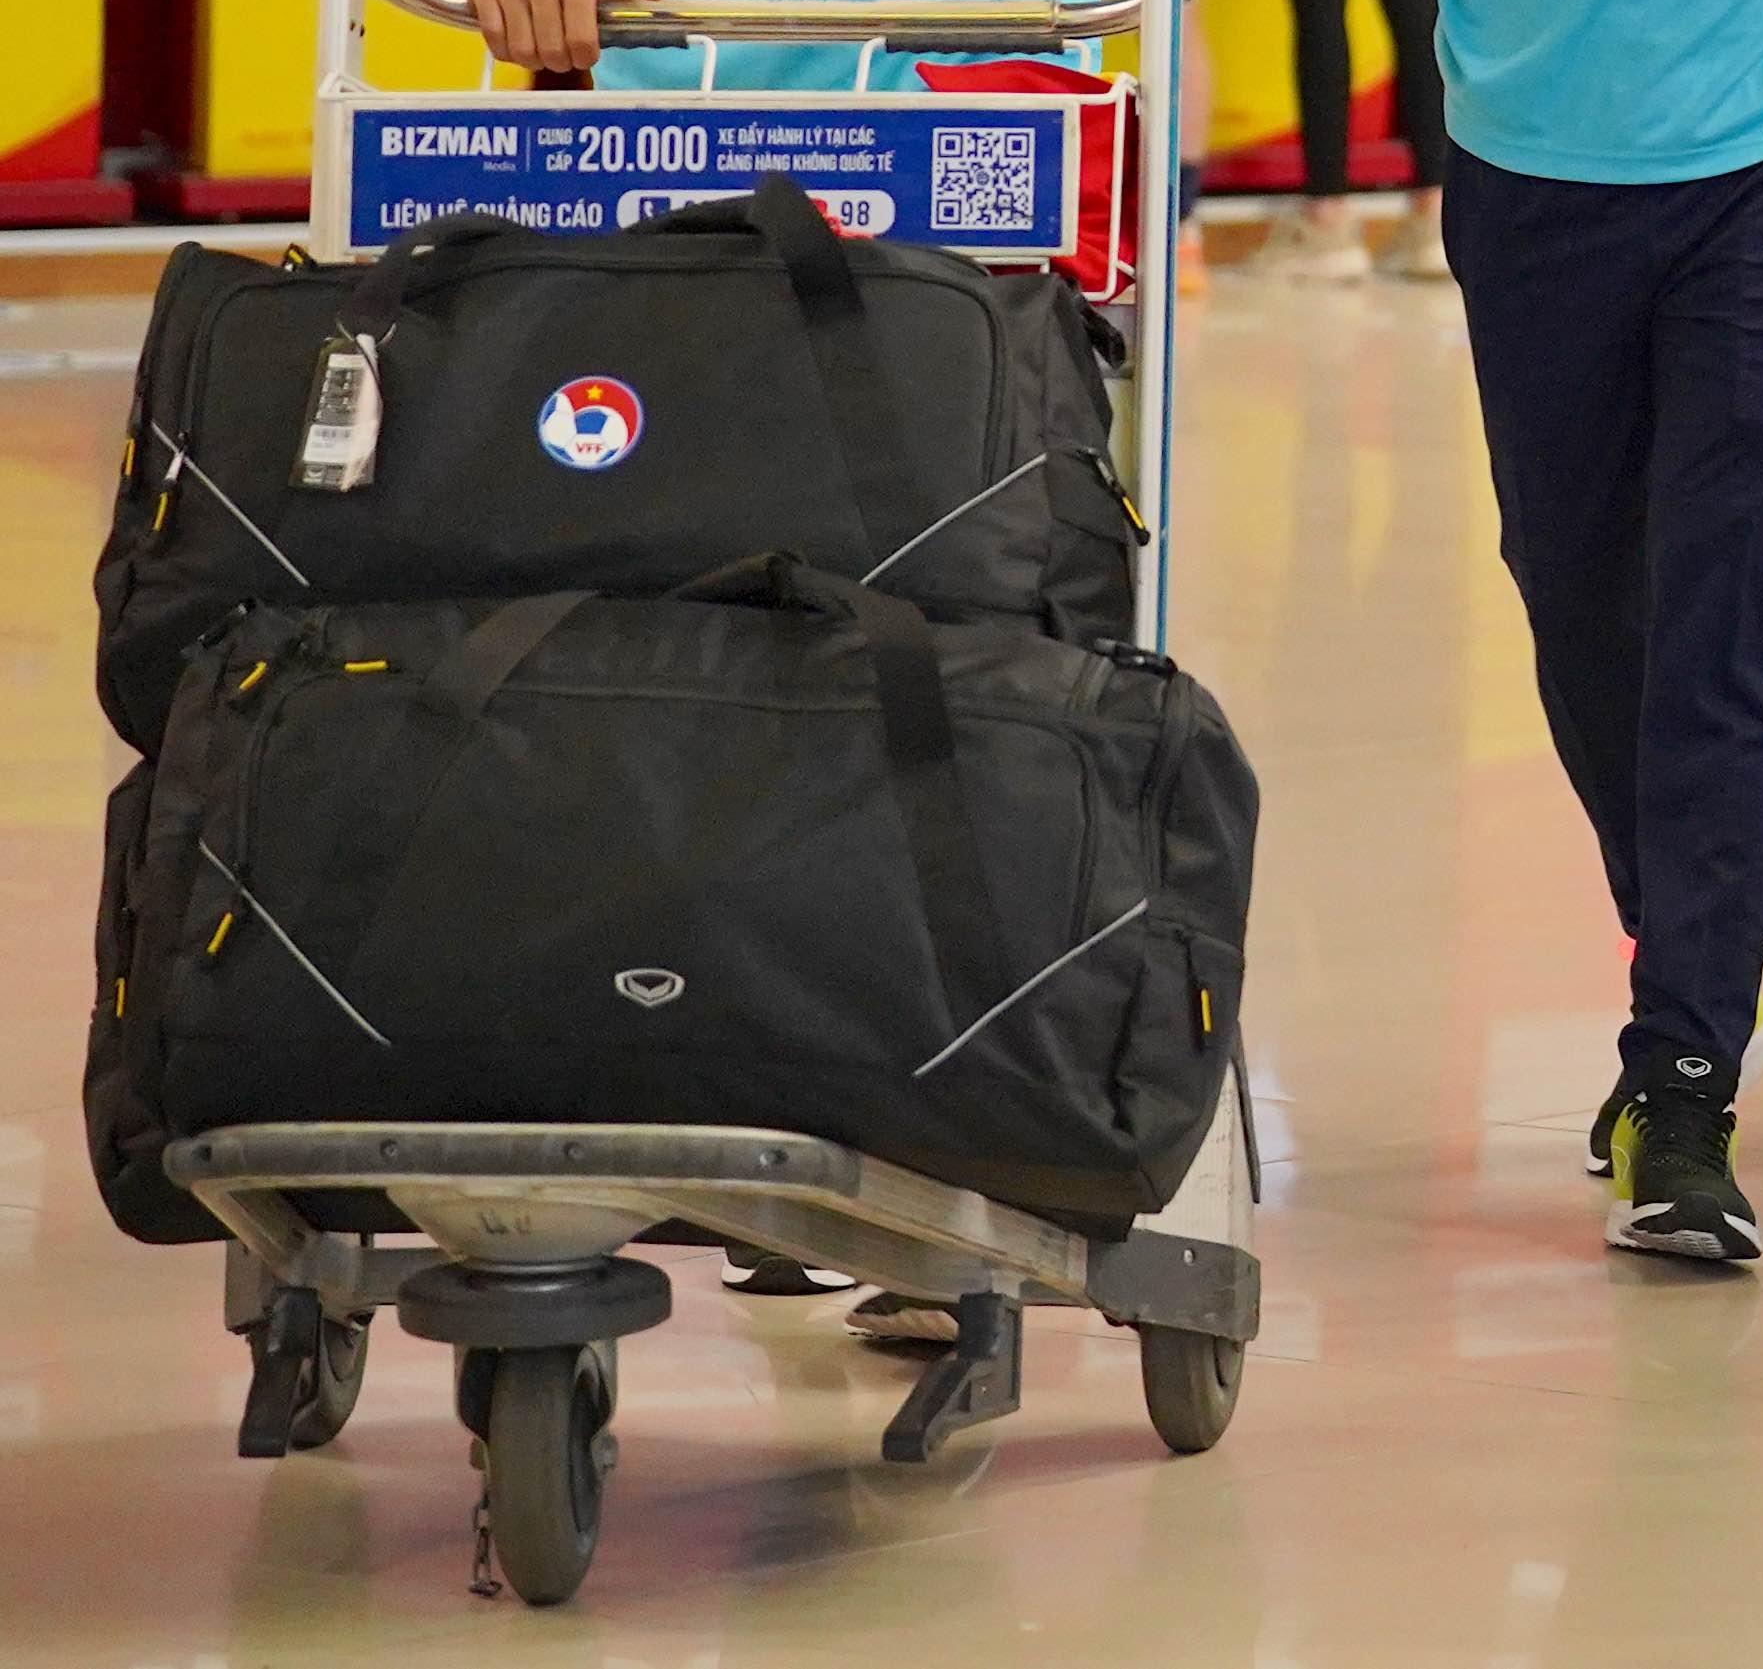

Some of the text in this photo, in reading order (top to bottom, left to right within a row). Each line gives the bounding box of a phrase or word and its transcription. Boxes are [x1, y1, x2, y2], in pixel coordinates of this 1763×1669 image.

[381, 126, 518, 156] BIZMAN
[537, 128, 573, 145] CUNG
[577, 125, 708, 172] 20.000
[717, 128, 735, 145] XE
[849, 124, 875, 145] CÁC
[546, 148, 573, 172] CẤP
[380, 198, 432, 228] LIÊN
[556, 198, 603, 228] CÁO
[576, 443, 603, 454] VFF
